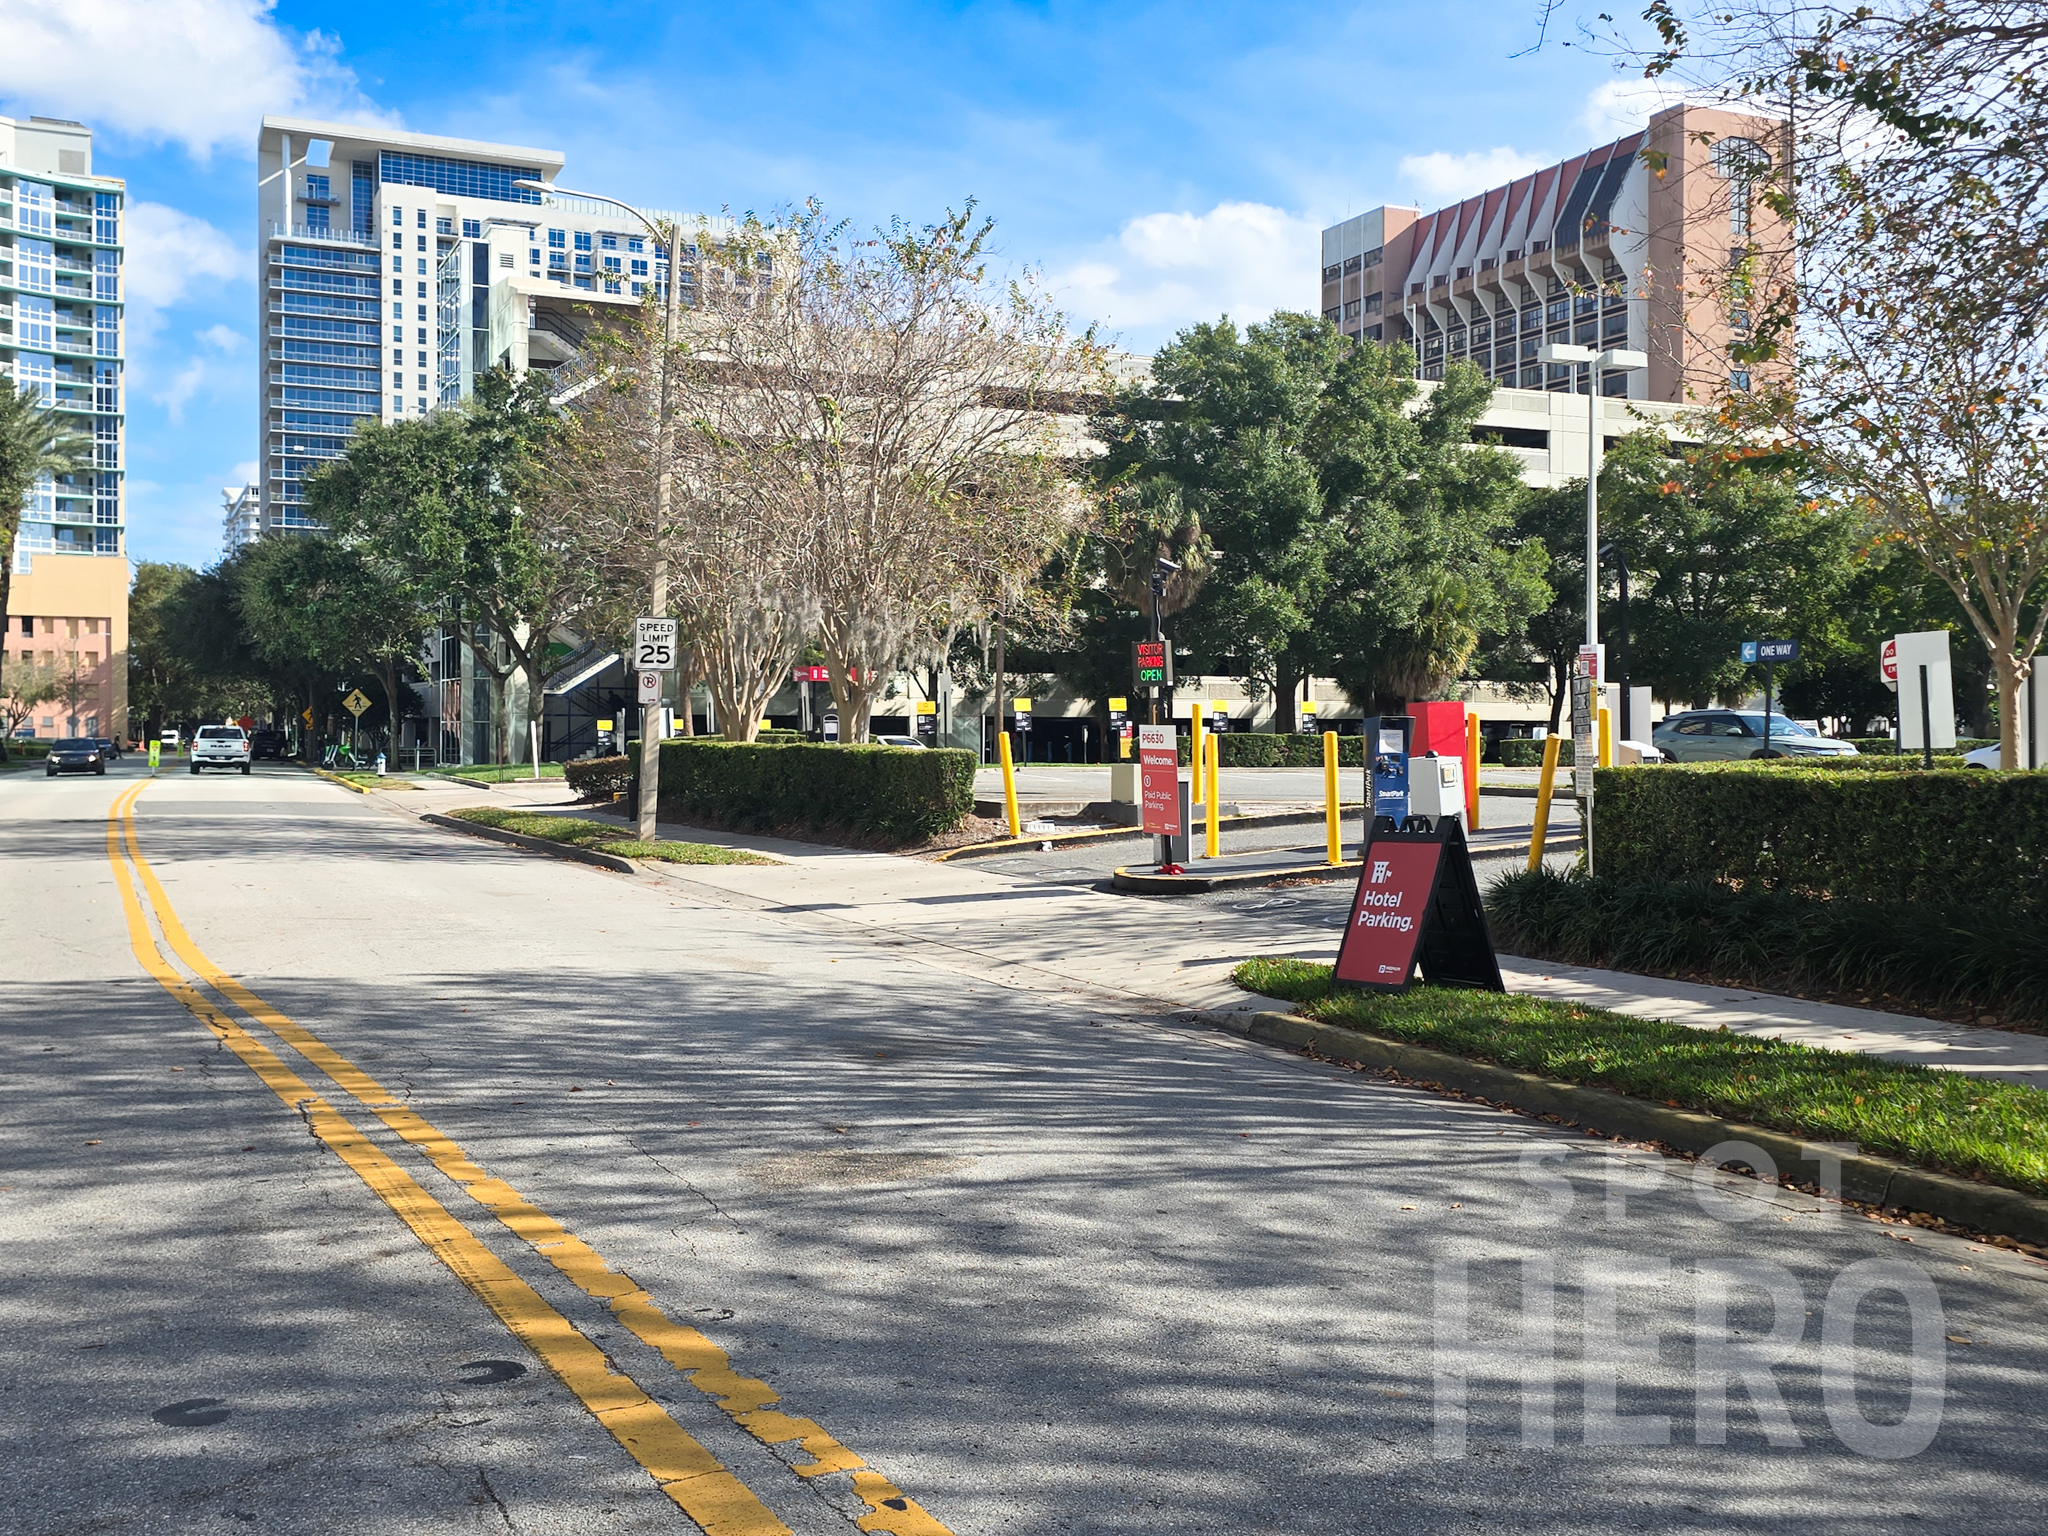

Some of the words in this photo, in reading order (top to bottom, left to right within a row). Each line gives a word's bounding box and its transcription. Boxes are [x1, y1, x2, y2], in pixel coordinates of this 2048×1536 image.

[639, 623, 674, 632] SPEED
[642, 634, 670, 643] LIMIT
[640, 645, 670, 664] 25
[1137, 643, 1163, 655] VISITOR
[1760, 645, 1776, 657] ONE
[1775, 644, 1792, 656] WAY
[1137, 655, 1164, 668] PARKING
[1141, 669, 1163, 681] OPEN
[1142, 733, 1164, 744] P6630
[1143, 754, 1174, 766] Welcome.
[1145, 790, 1156, 799] Paid
[1156, 791, 1172, 801] Public
[1379, 790, 1404, 798] SmartPark
[1145, 800, 1164, 811] Parking.
[1363, 890, 1403, 908] Hotel
[1357, 910, 1414, 932] Parking.
